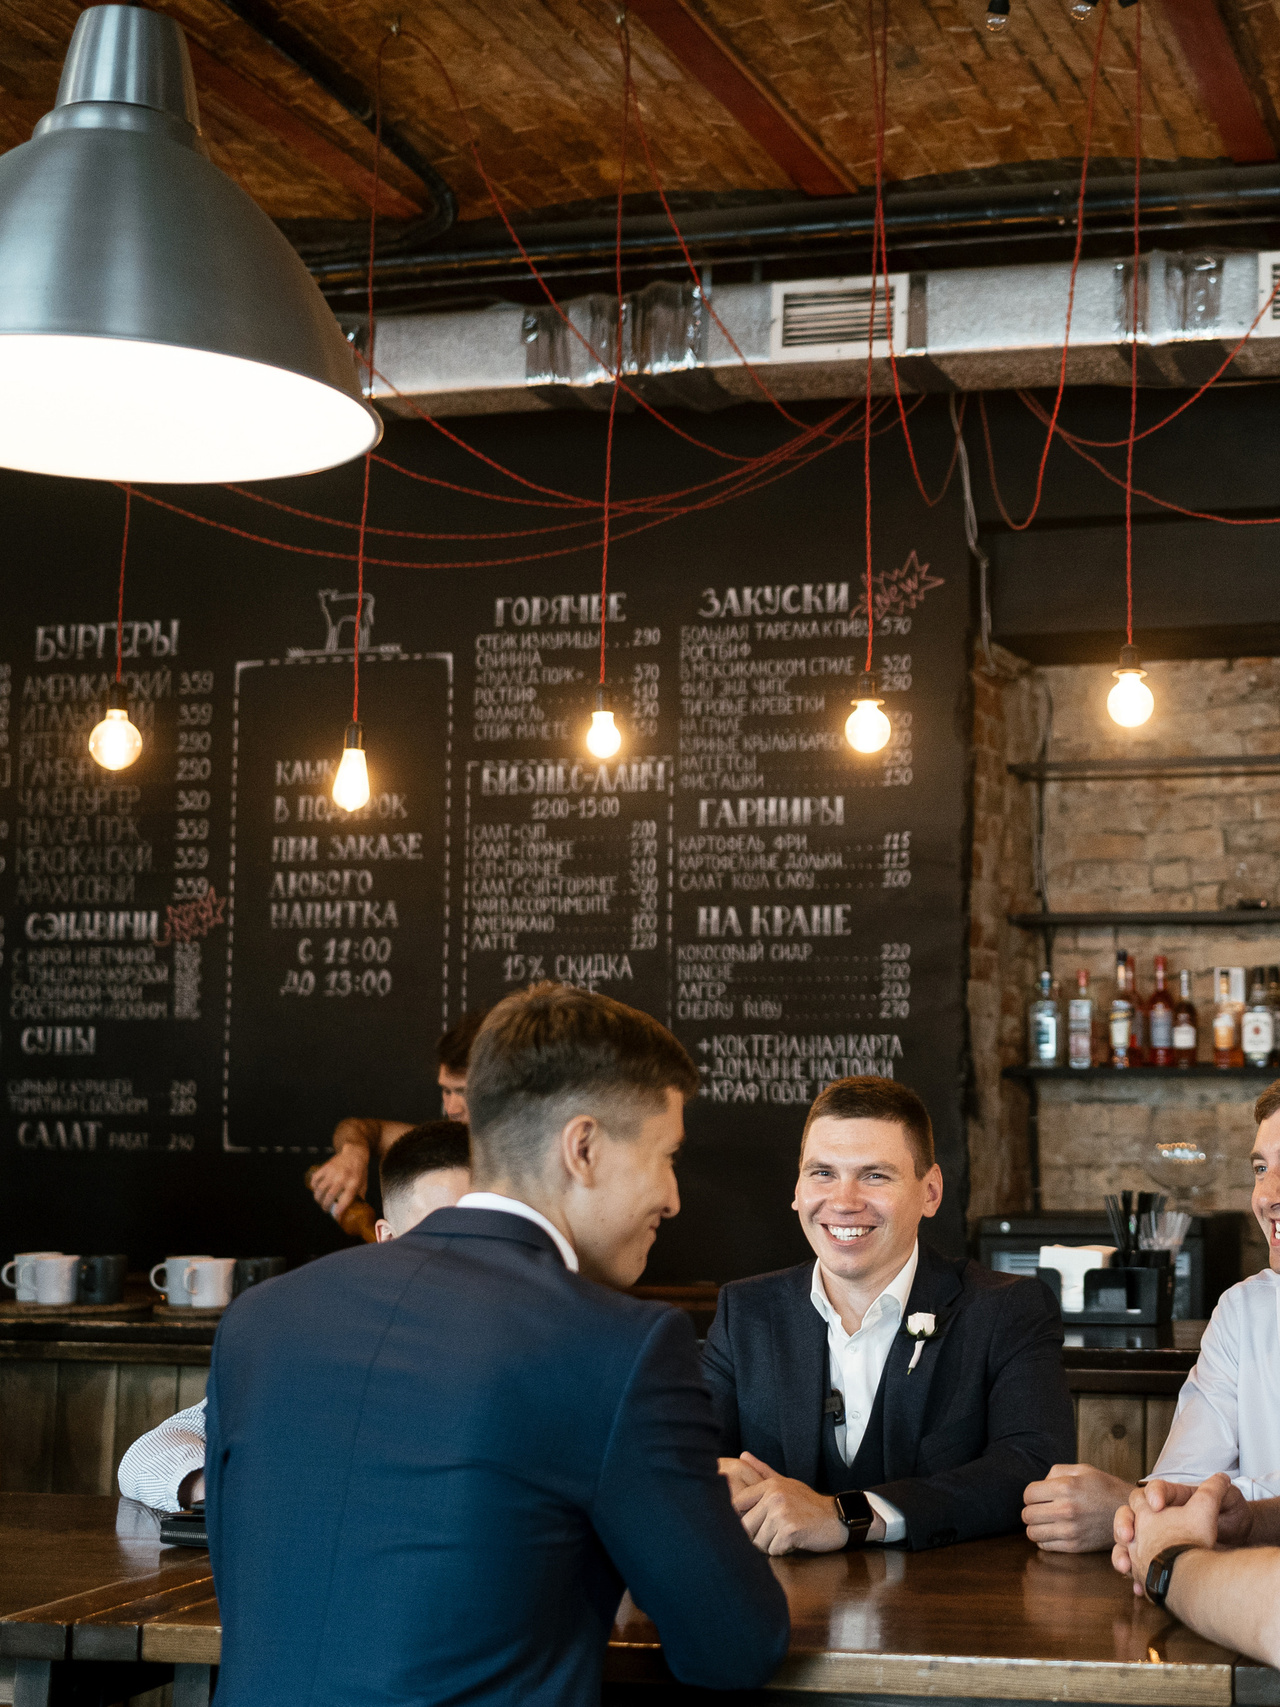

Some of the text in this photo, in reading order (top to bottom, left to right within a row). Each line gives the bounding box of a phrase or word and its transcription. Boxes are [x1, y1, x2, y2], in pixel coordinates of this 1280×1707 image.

[698, 582, 850, 618] ЗАКУСКИ
[35, 619, 180, 662] БУРГЕРЫ
[680, 624, 750, 643] БОЛЬШАЯ
[755, 620, 820, 641] ТАРЕЛКА
[680, 642, 752, 662] РОСТБИФ
[809, 655, 856, 676] СТИЛЕ
[751, 677, 790, 696] ЧИПС
[680, 694, 825, 717] ТИГРОВЫЕ КРЕВЕТКИ
[481, 762, 665, 796] БИЗНЕС-ЛАНЧ
[679, 772, 765, 791] ФИСТАШКИ
[273, 792, 410, 824] В ПОРОК
[698, 795, 845, 828] ГАРНИРЫ
[271, 832, 424, 863] ПРИ ЗАКАЗЕ
[678, 834, 766, 853] КАРТОФЕЛЬ
[772, 833, 808, 852] ФРИ
[678, 853, 780, 872] КАРТОФЕЛЬНЫЕ
[784, 851, 844, 872] ДОЛЬКИ
[678, 871, 725, 892] САЛАТ
[731, 872, 770, 891] КОУЛ
[270, 900, 400, 930] НАПИТКА
[471, 914, 556, 933] АМЕРИКАНО
[697, 903, 852, 937] НА КРАНЕ
[296, 936, 392, 966] С 11:00
[471, 932, 518, 952] ЛАТТЕ
[677, 938, 765, 962] КОКОСОВЫЙ
[503, 953, 634, 982] 15% СКИДКА
[322, 968, 393, 998] 13:00
[678, 981, 727, 1001] ЛАГЕР
[20, 1026, 97, 1056] СУПЫ
[847, 1033, 904, 1059] КАРТА
[17, 1120, 103, 1151] САЛАТ
